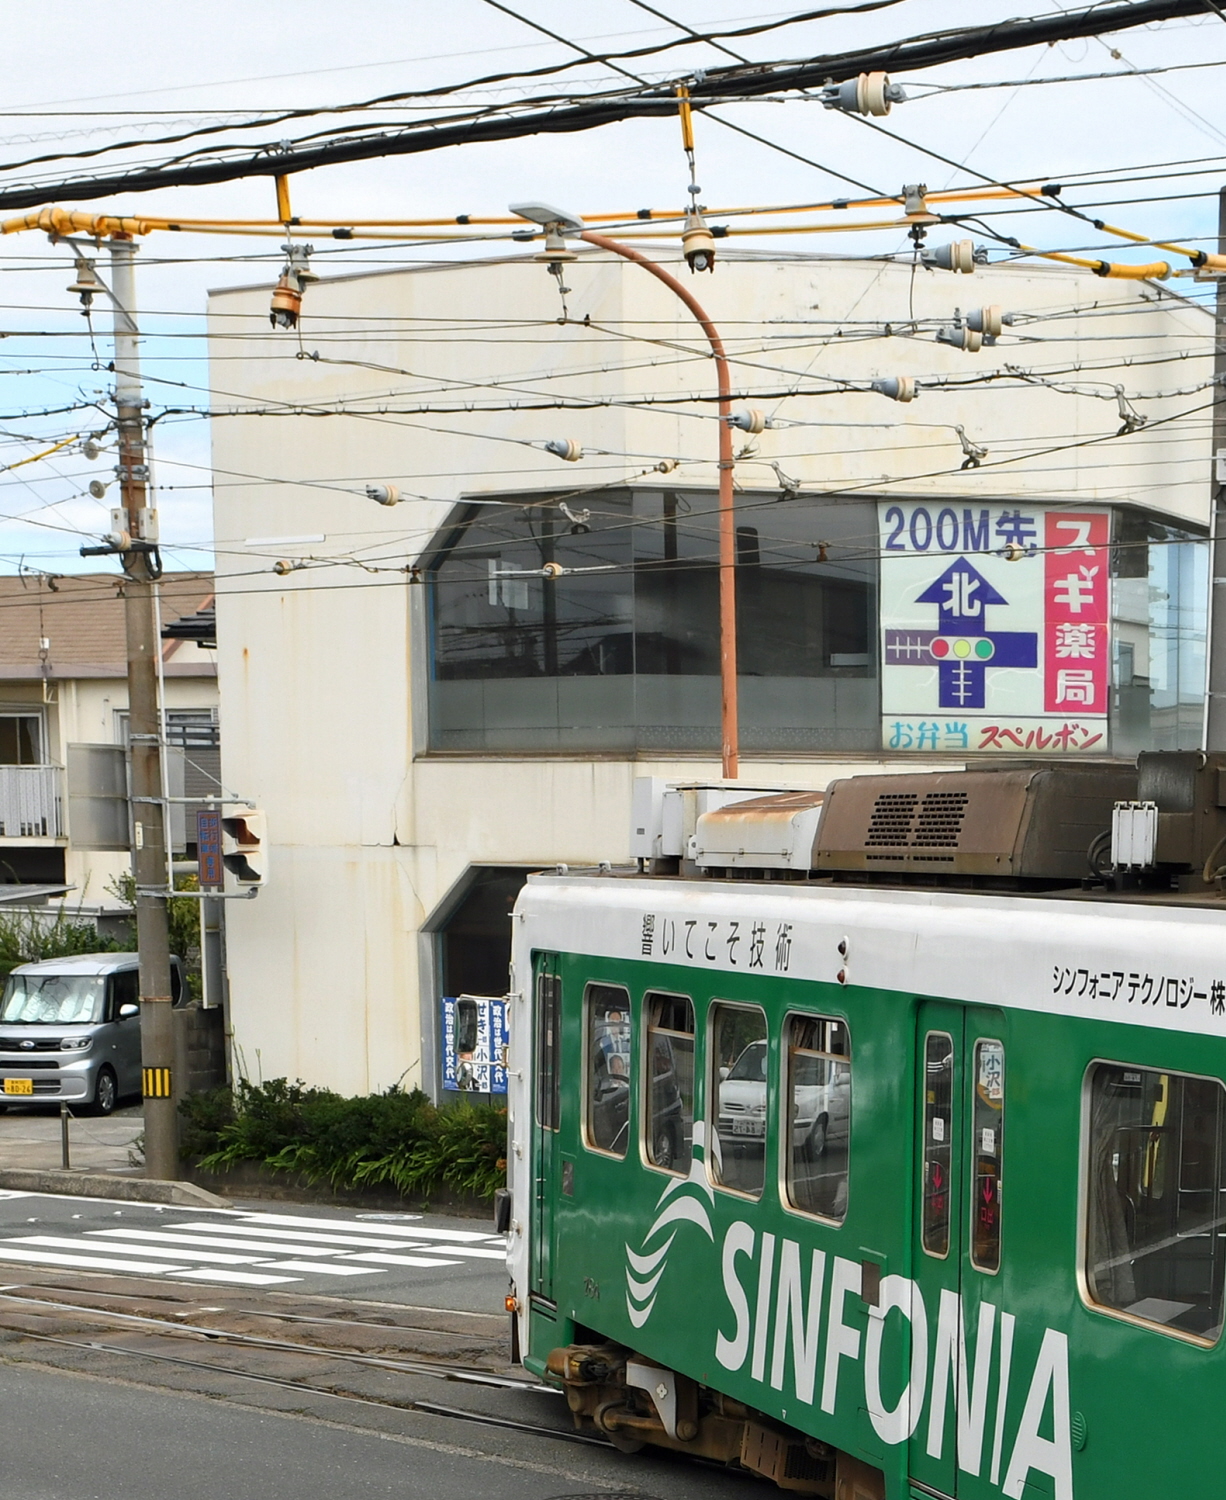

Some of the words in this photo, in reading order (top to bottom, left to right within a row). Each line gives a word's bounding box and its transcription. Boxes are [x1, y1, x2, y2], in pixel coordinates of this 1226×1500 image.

[885, 506, 1038, 557] 200M先
[942, 572, 981, 617] 北
[1053, 519, 1099, 706] スギ薬局
[889, 721, 968, 749] お弁当
[978, 723, 1103, 751] スペルボン
[641, 914, 793, 971] 響いてこそ技術
